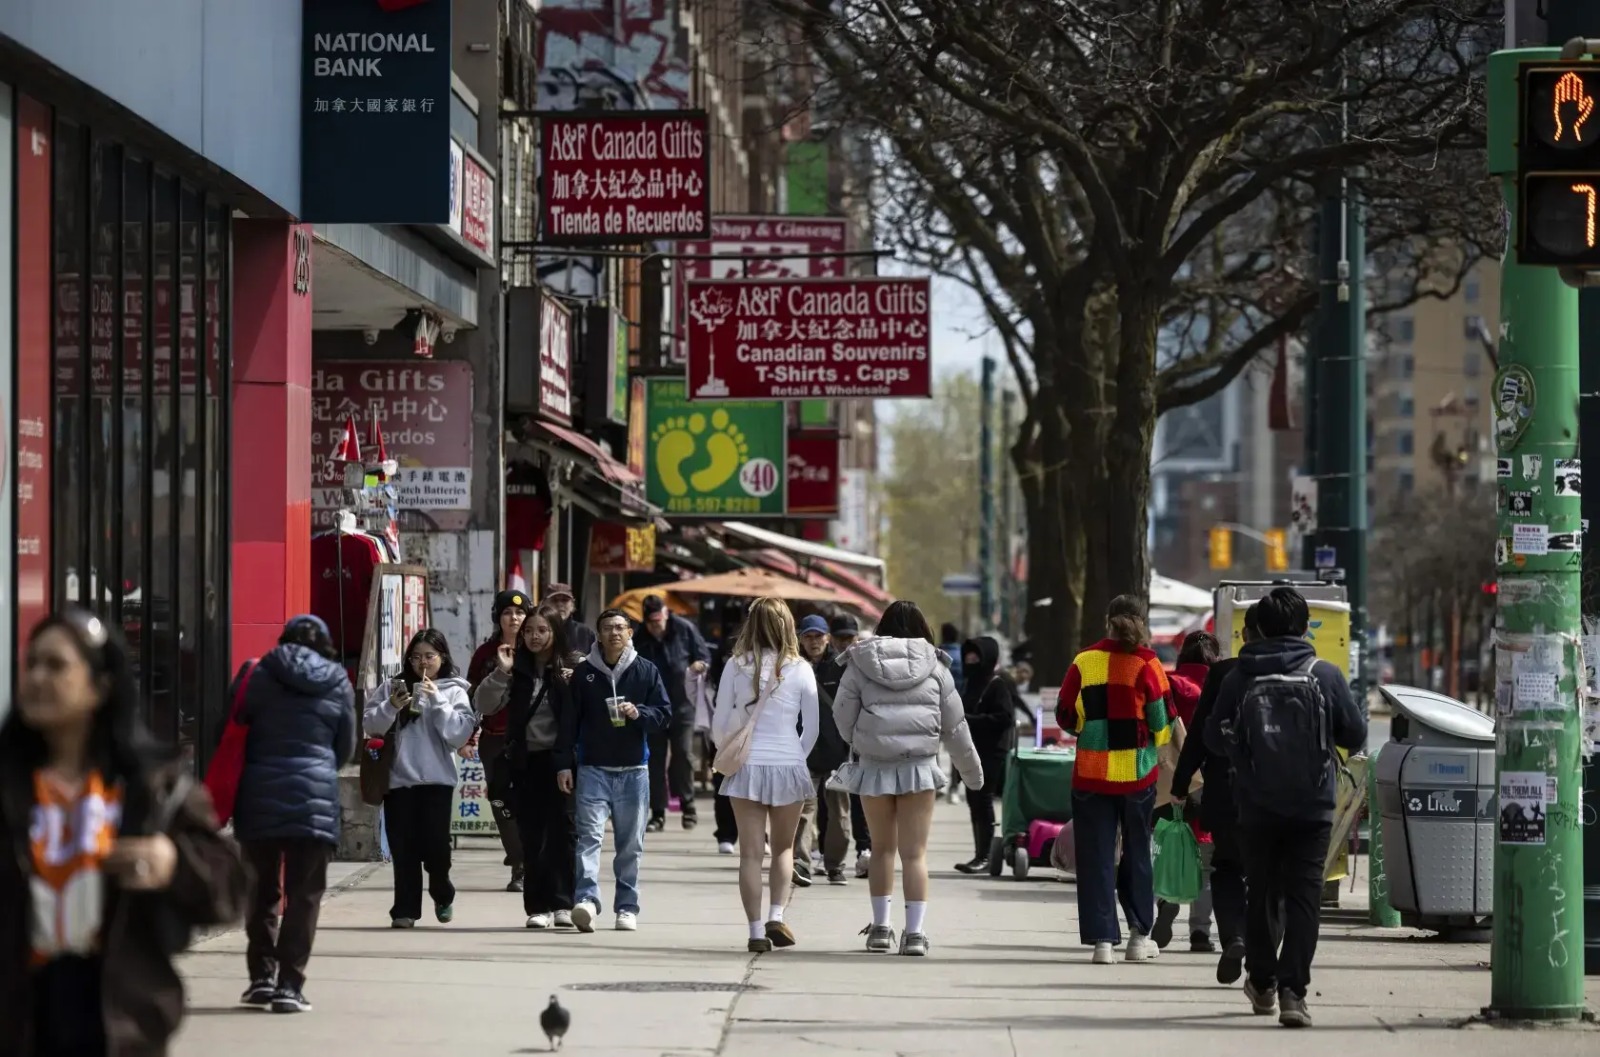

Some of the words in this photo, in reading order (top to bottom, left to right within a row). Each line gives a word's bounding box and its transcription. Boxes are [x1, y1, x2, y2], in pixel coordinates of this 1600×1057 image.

[314, 32, 435, 53] NATIONAL
[314, 58, 382, 77] BANK
[314, 98, 435, 113] 加拿大國家銀行
[549, 122, 588, 161] A&F
[591, 121, 657, 160] Canada
[661, 120, 703, 159] Gifts
[551, 167, 703, 200] 加拿大纪念品中心
[550, 204, 601, 234] Tienda
[604, 205, 623, 233] de
[626, 203, 704, 233] Recuerdos
[1571, 184, 1596, 247] 7
[775, 222, 842, 241] Ginseng
[735, 285, 783, 316] A&F
[787, 284, 870, 316] Canada
[875, 283, 927, 315] Gifts
[736, 317, 927, 341] 加拿大纪念品中心
[736, 343, 826, 363] Canadian
[832, 341, 927, 362] Souvenirs
[360, 369, 445, 391] Gifts
[755, 365, 838, 382] T-Shirts
[857, 364, 910, 384] Caps
[771, 386, 809, 396] Retail
[812, 386, 822, 396] &
[824, 385, 891, 396] Wholesale
[329, 428, 435, 445] Rcerdos
[324, 461, 335, 481] 3
[396, 485, 421, 495] atch
[424, 485, 467, 495] Batteries
[397, 495, 458, 506] Replacement
